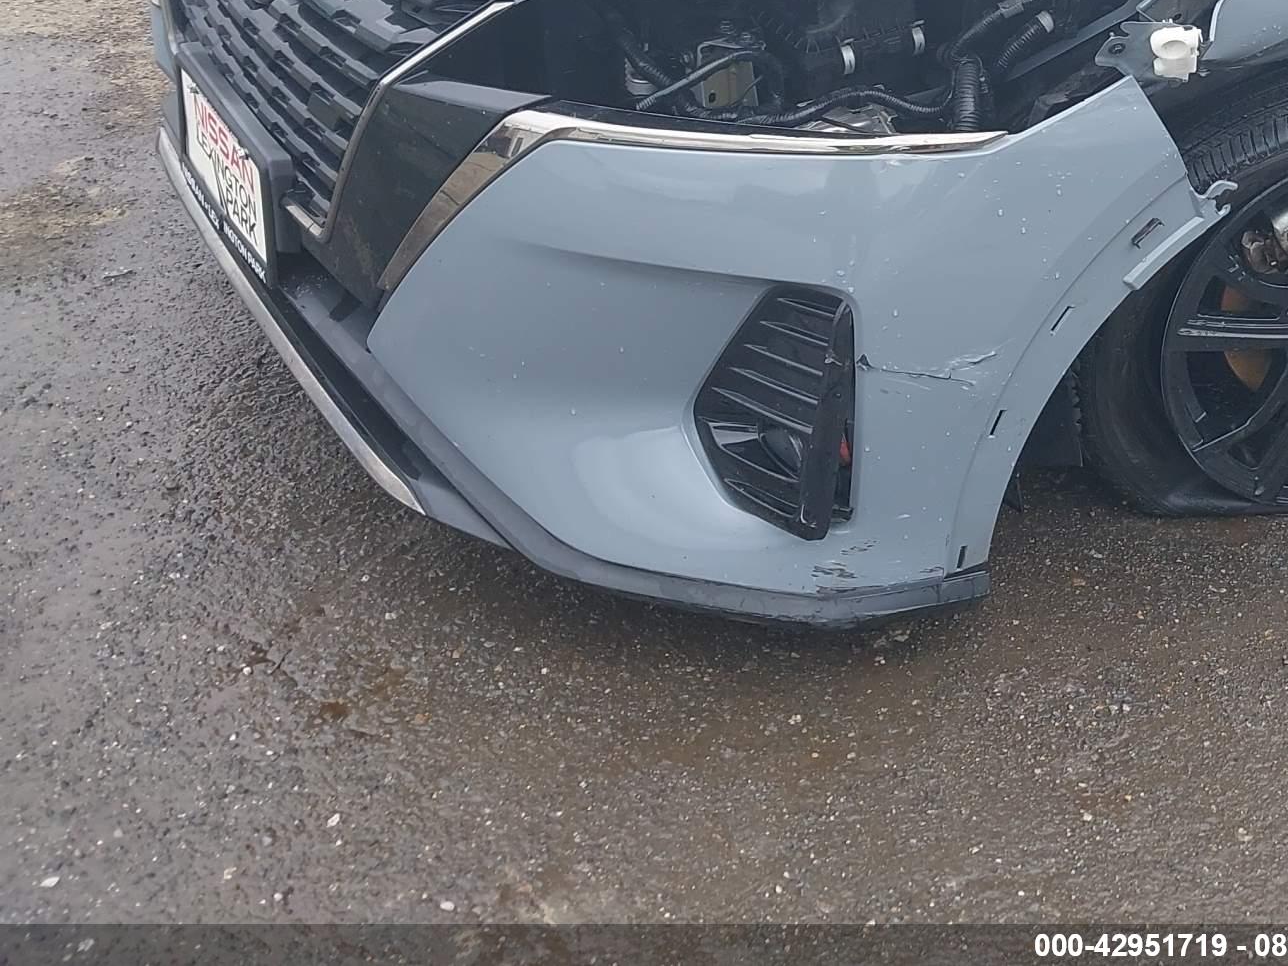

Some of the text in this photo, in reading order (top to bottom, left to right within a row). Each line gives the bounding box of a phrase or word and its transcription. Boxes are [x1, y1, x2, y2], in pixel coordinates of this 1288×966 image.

[194, 94, 255, 194] NISSAN
[196, 121, 257, 224] LEXINGTON
[225, 185, 258, 247] PARK
